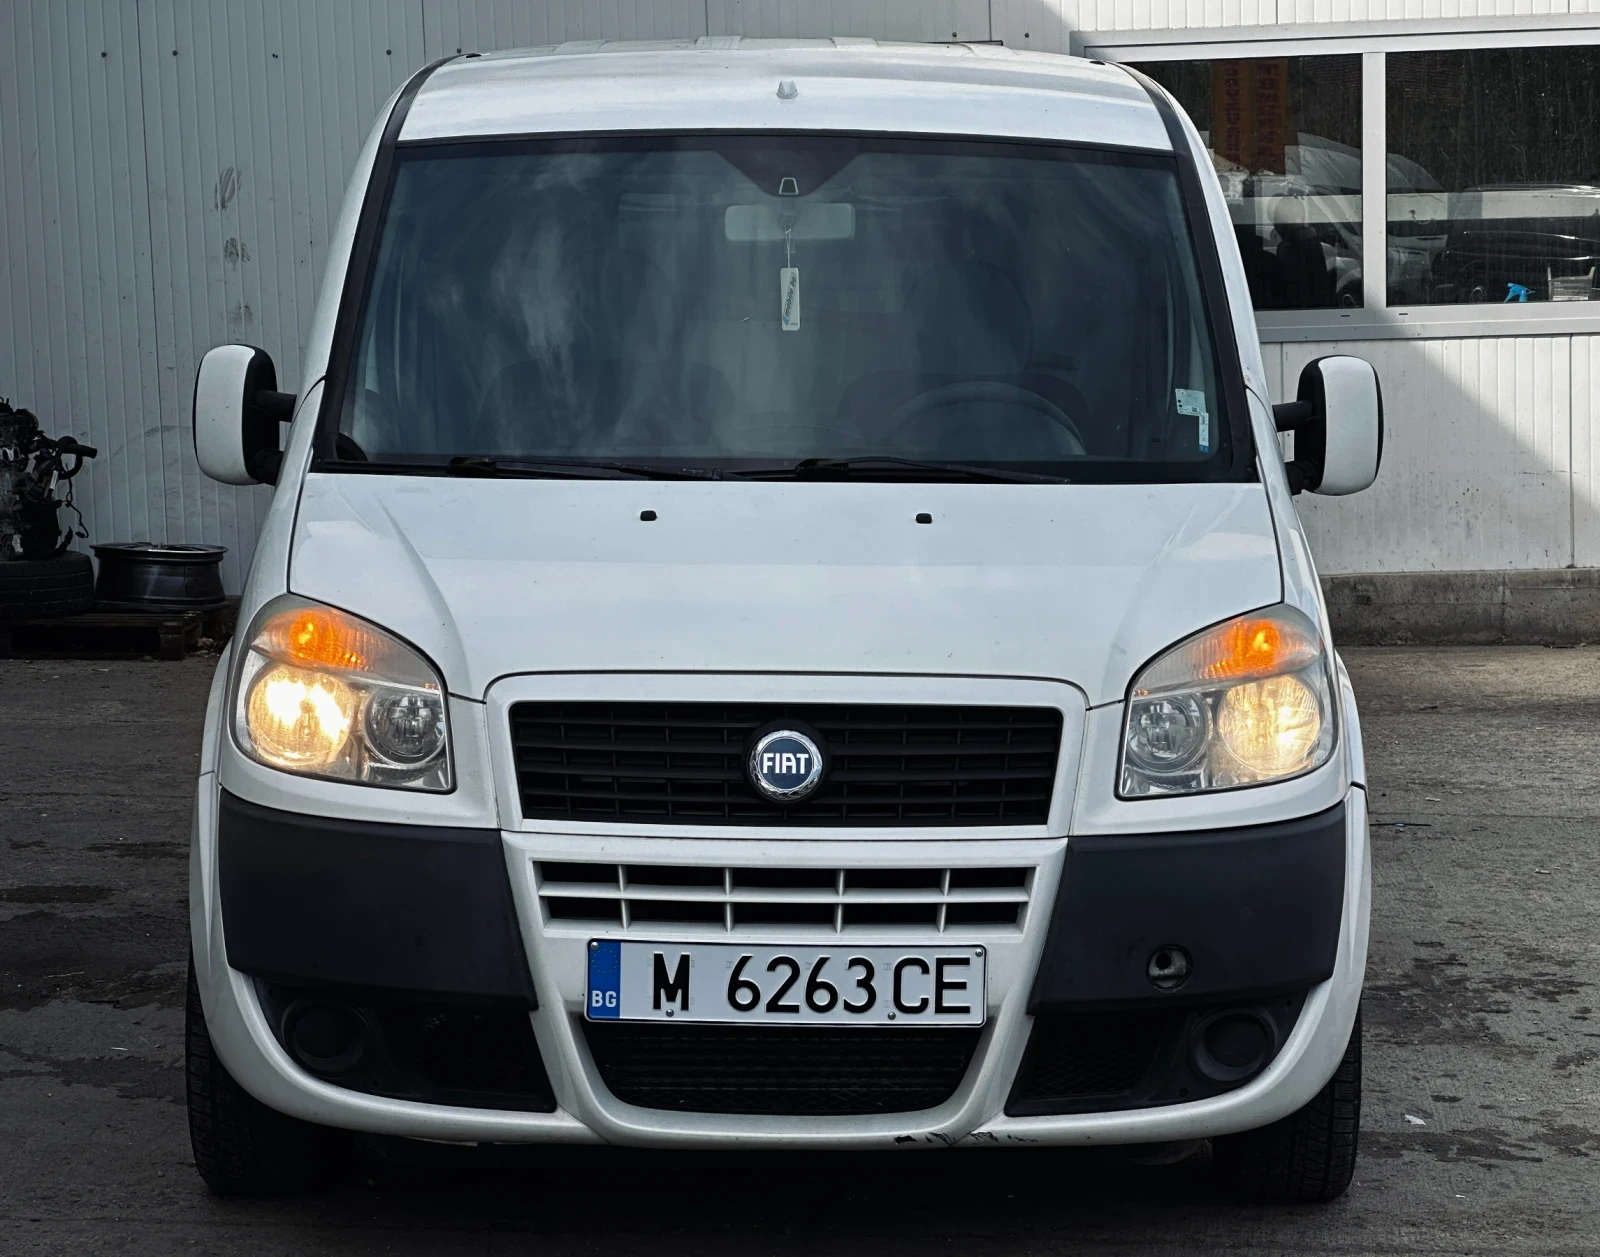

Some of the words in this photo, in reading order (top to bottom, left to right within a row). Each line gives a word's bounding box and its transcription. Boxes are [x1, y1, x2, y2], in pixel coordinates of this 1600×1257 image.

[763, 753, 809, 774] FIAT
[652, 952, 690, 1011] M
[727, 955, 877, 1013] 6263
[892, 957, 971, 1014] CE
[592, 990, 617, 1007] BG
